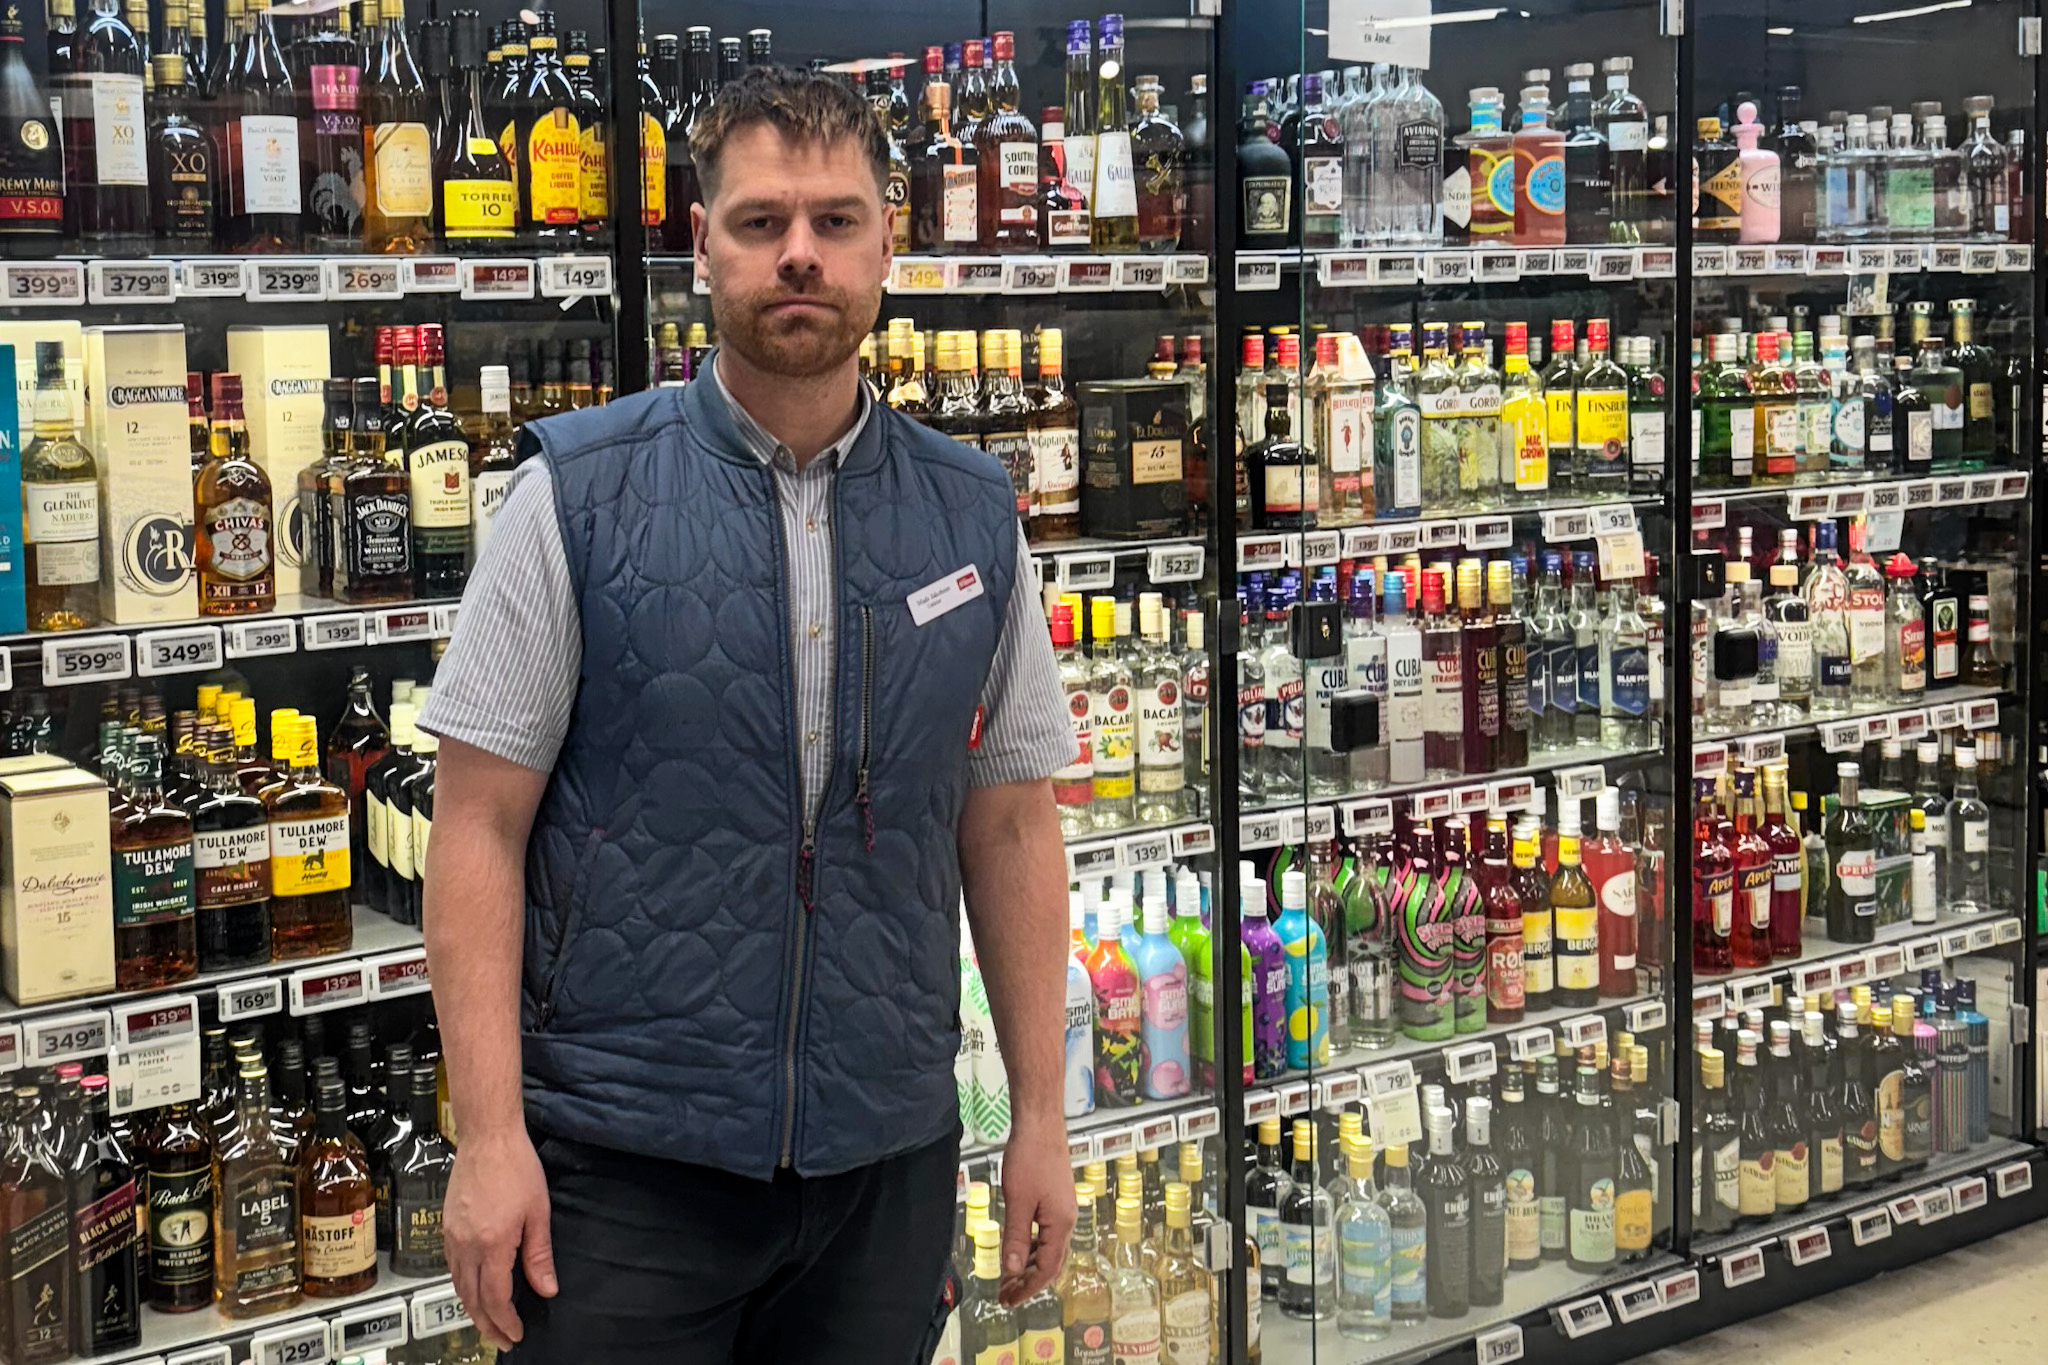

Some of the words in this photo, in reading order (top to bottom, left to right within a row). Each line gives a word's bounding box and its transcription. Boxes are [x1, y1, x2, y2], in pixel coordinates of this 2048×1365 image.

[112, 124, 135, 138] XO
[171, 153, 206, 173] XO
[885, 182, 905, 198] 43
[482, 204, 501, 217] 10
[126, 421, 139, 434] 12
[1525, 434, 1542, 446] MAC
[1149, 445, 1166, 458] 15
[65, 491, 81, 500] THE
[482, 488, 504, 507] JIM
[43, 497, 96, 513] GLENLIVET
[356, 503, 376, 520] JACK
[214, 516, 264, 531] CHIVAS
[364, 546, 403, 555] WHISKEY
[212, 583, 231, 596] XII
[254, 582, 266, 594] 12
[1395, 658, 1421, 678] CUBA
[1094, 714, 1133, 727] BACAR
[1143, 707, 1182, 720] BACAR
[278, 819, 345, 838] TULLAMORE
[198, 830, 266, 849] TULLAMORE
[123, 844, 191, 867] TULLAMORE
[241, 1193, 289, 1217] LABEL
[260, 1212, 272, 1227] 5
[411, 1208, 443, 1226] RÅST
[79, 1223, 108, 1245] BLACK
[109, 1206, 133, 1229] RUBY
